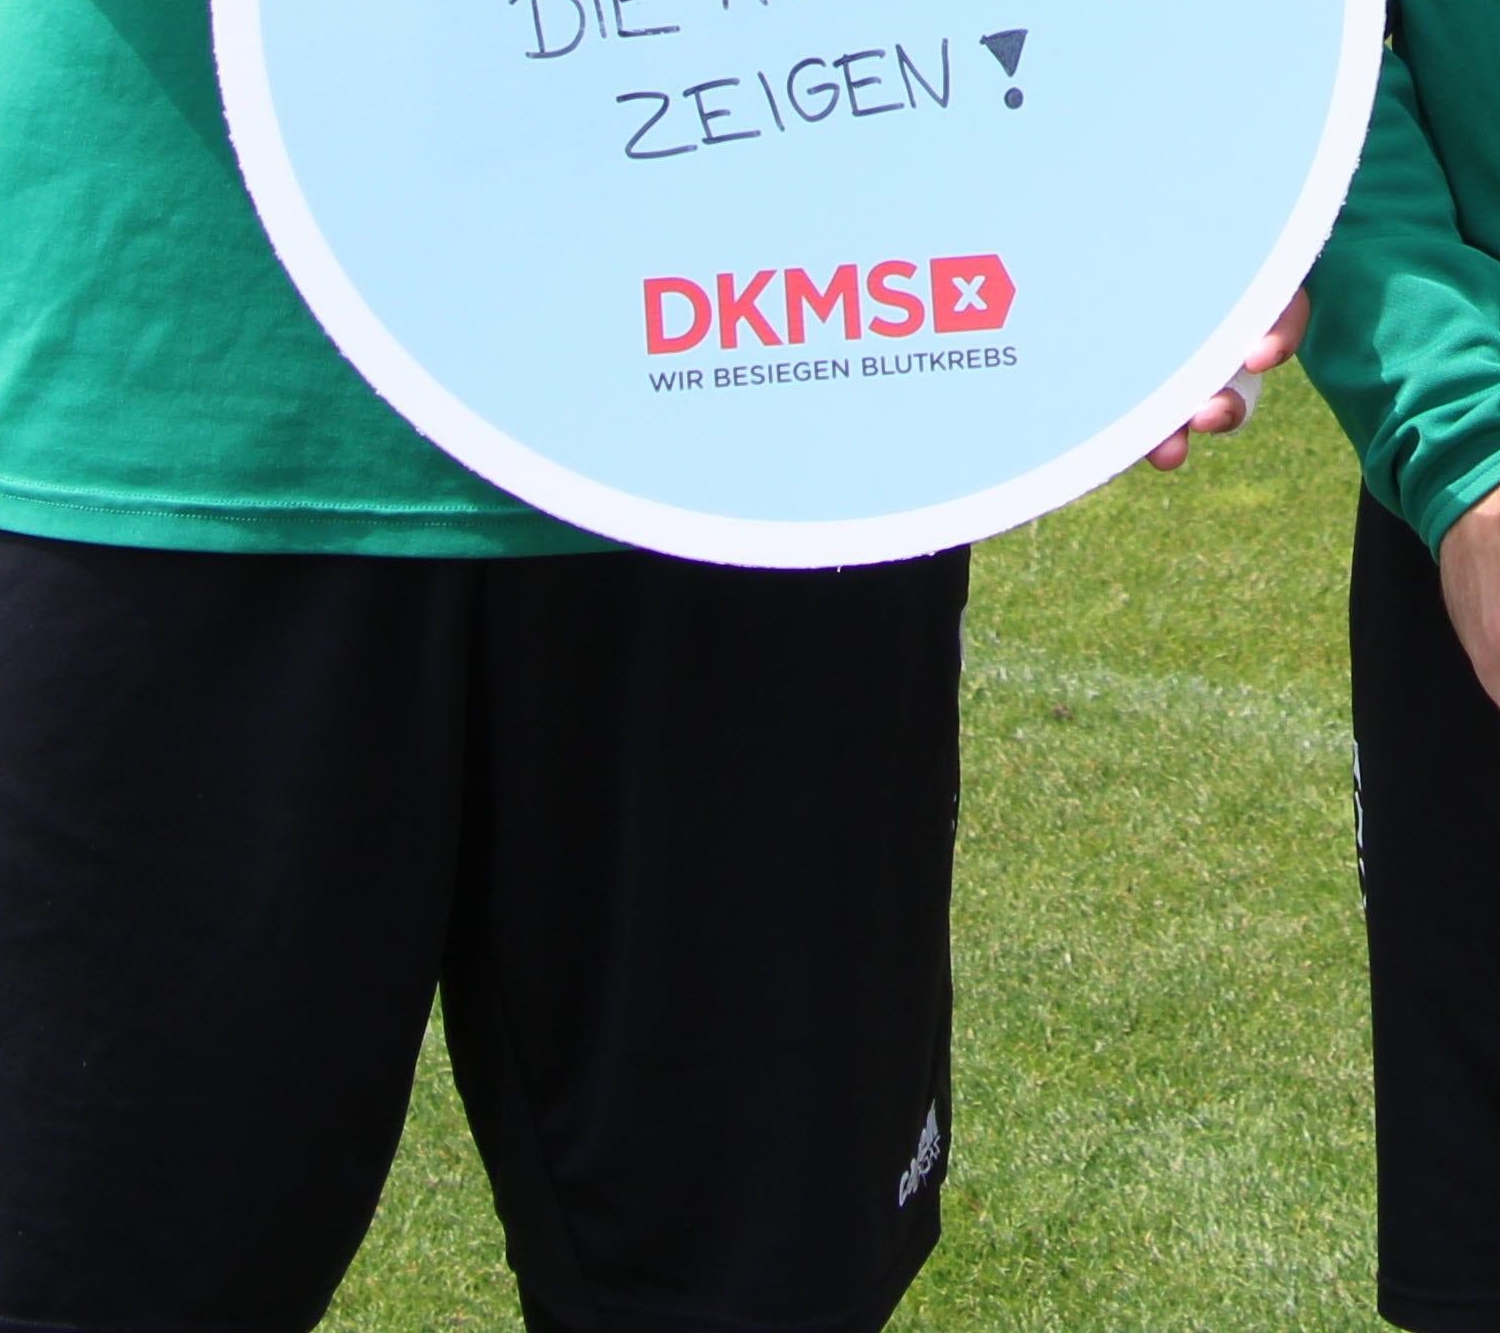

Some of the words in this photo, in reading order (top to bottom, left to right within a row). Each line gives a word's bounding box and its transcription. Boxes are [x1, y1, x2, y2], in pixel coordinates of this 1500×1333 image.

[643, 259, 926, 356] DKMS
[648, 369, 705, 393] WIR
[713, 357, 851, 388] BESIEGEN
[861, 345, 1019, 377] BLUTKREBS
